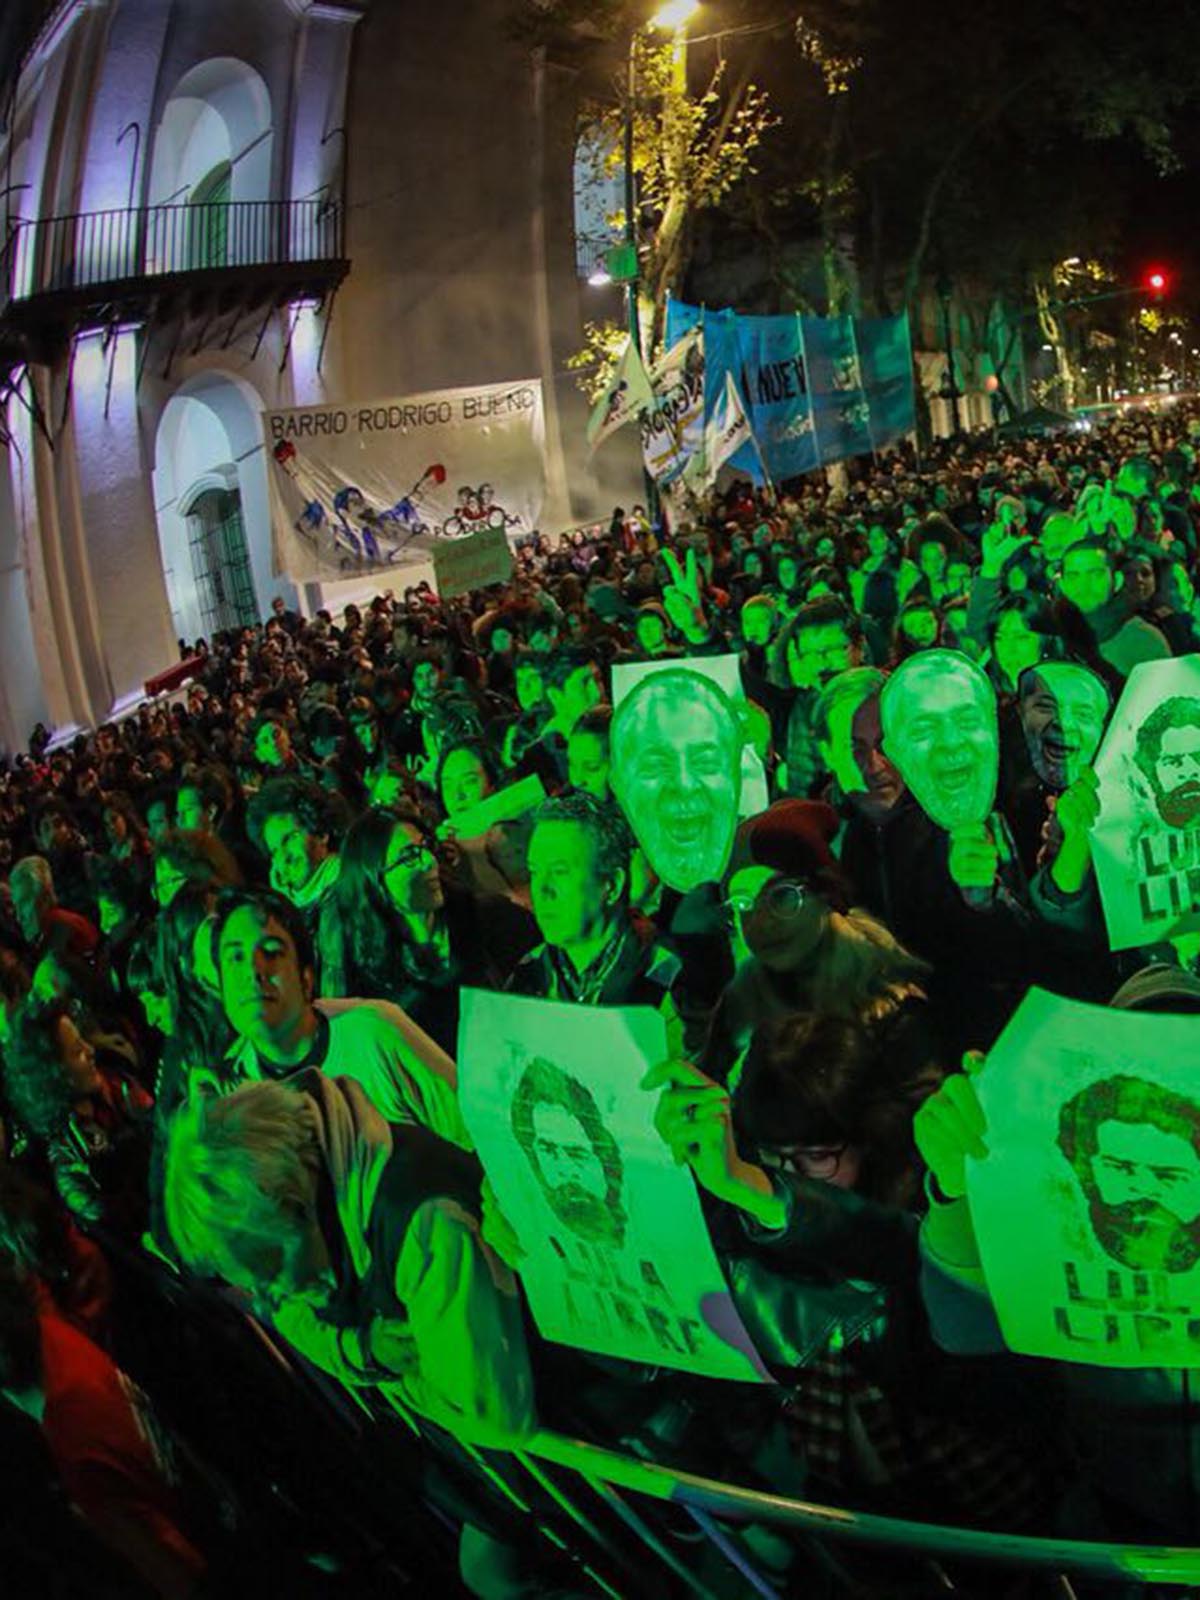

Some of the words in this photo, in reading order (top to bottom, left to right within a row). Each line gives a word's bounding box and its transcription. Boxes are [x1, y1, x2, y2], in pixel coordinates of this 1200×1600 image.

[270, 411, 347, 439] BARRIO
[357, 401, 452, 433] RODRIGO
[462, 387, 535, 419] BUENO
